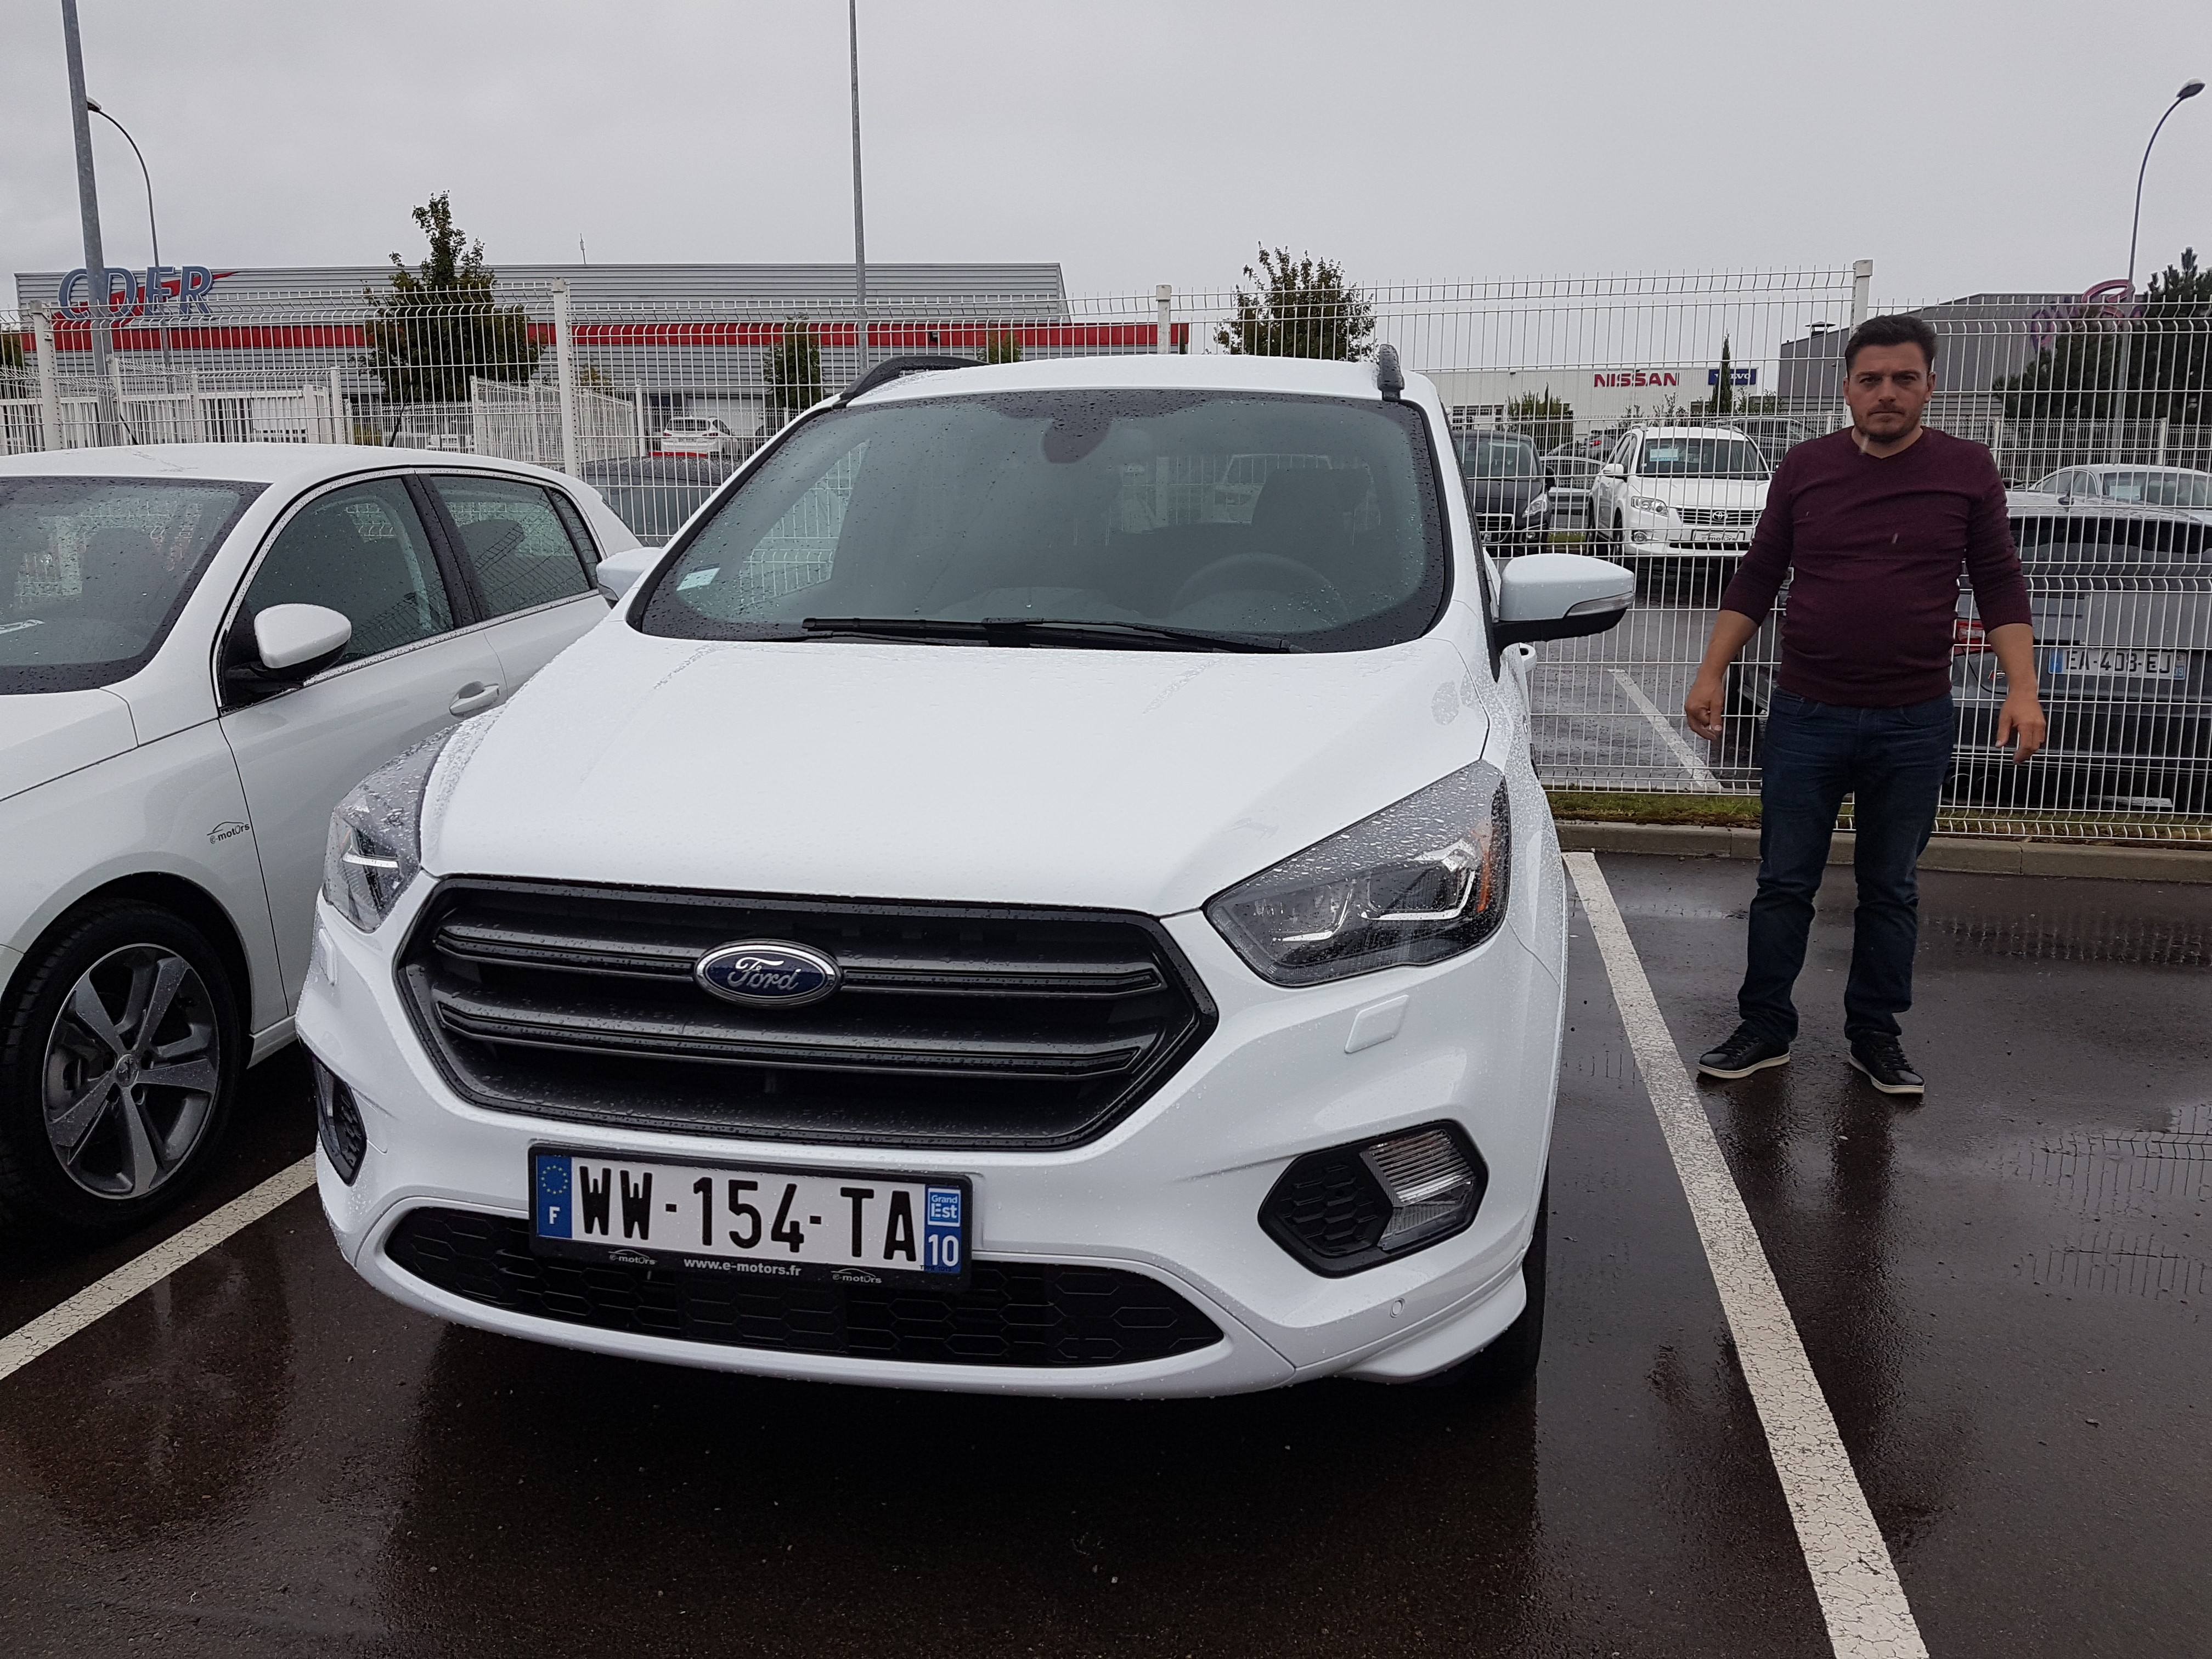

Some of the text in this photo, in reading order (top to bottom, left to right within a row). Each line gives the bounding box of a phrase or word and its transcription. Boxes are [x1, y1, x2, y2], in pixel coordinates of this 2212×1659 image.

[1594, 373, 1679, 387] NISSAN
[727, 957, 802, 990] Ford
[931, 1194, 958, 1204] Grand
[549, 1206, 561, 1224] F
[579, 1165, 916, 1262] WW-154-TA
[931, 1203, 957, 1218] Est
[928, 1234, 959, 1267] 10
[684, 1257, 802, 1276] www.e-motors.fr
